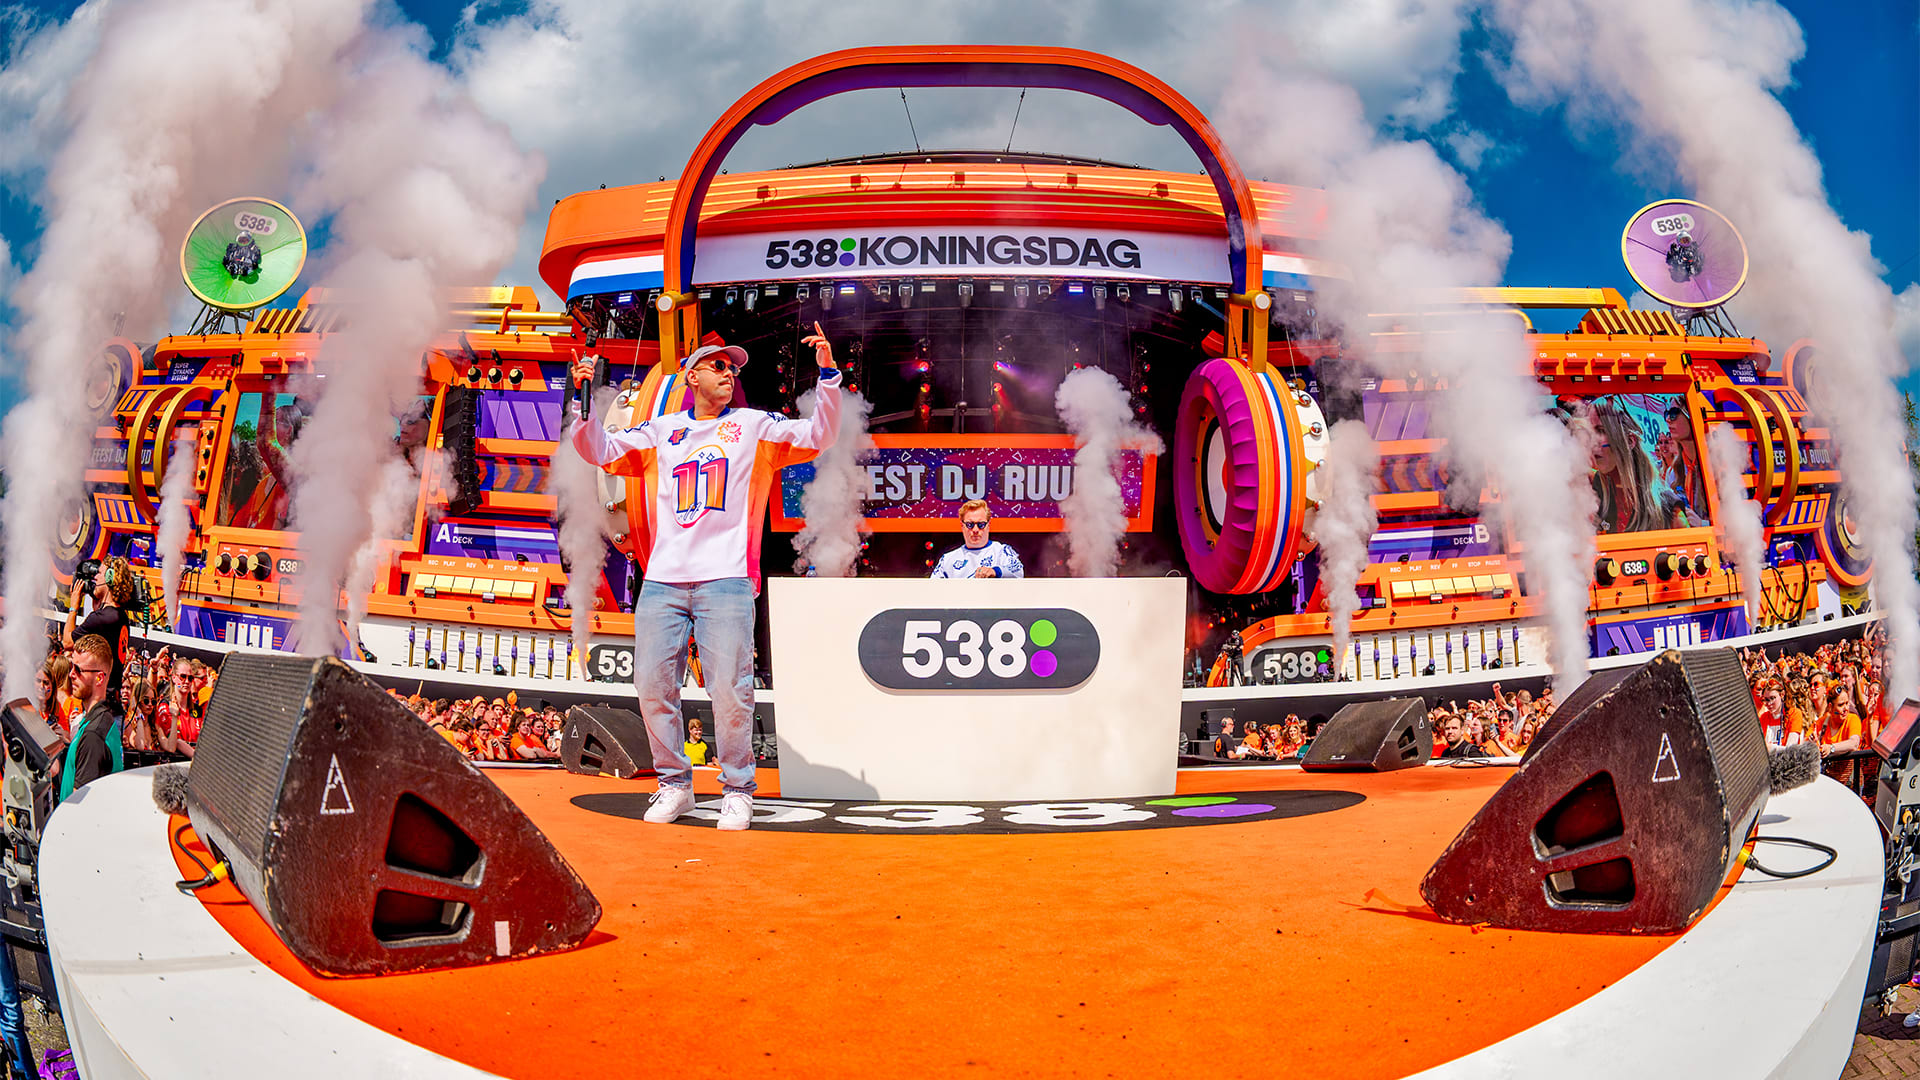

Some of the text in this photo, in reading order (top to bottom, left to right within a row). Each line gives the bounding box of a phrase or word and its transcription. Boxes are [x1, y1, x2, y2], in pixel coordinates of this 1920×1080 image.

[239, 214, 266, 231] 538
[1656, 217, 1683, 233] 538
[858, 235, 1141, 268] KONINGSDAG
[672, 457, 729, 513] 11
[942, 465, 986, 500] DJ
[1004, 465, 1077, 500] RUU
[435, 523, 473, 545] A DECK
[1453, 524, 1490, 545] DECK B
[279, 560, 298, 573] 538
[504, 564, 518, 572] STOP
[1624, 561, 1643, 575] 538
[902, 619, 1027, 678] 538
[598, 649, 634, 678] 53
[1264, 651, 1317, 679] 538
